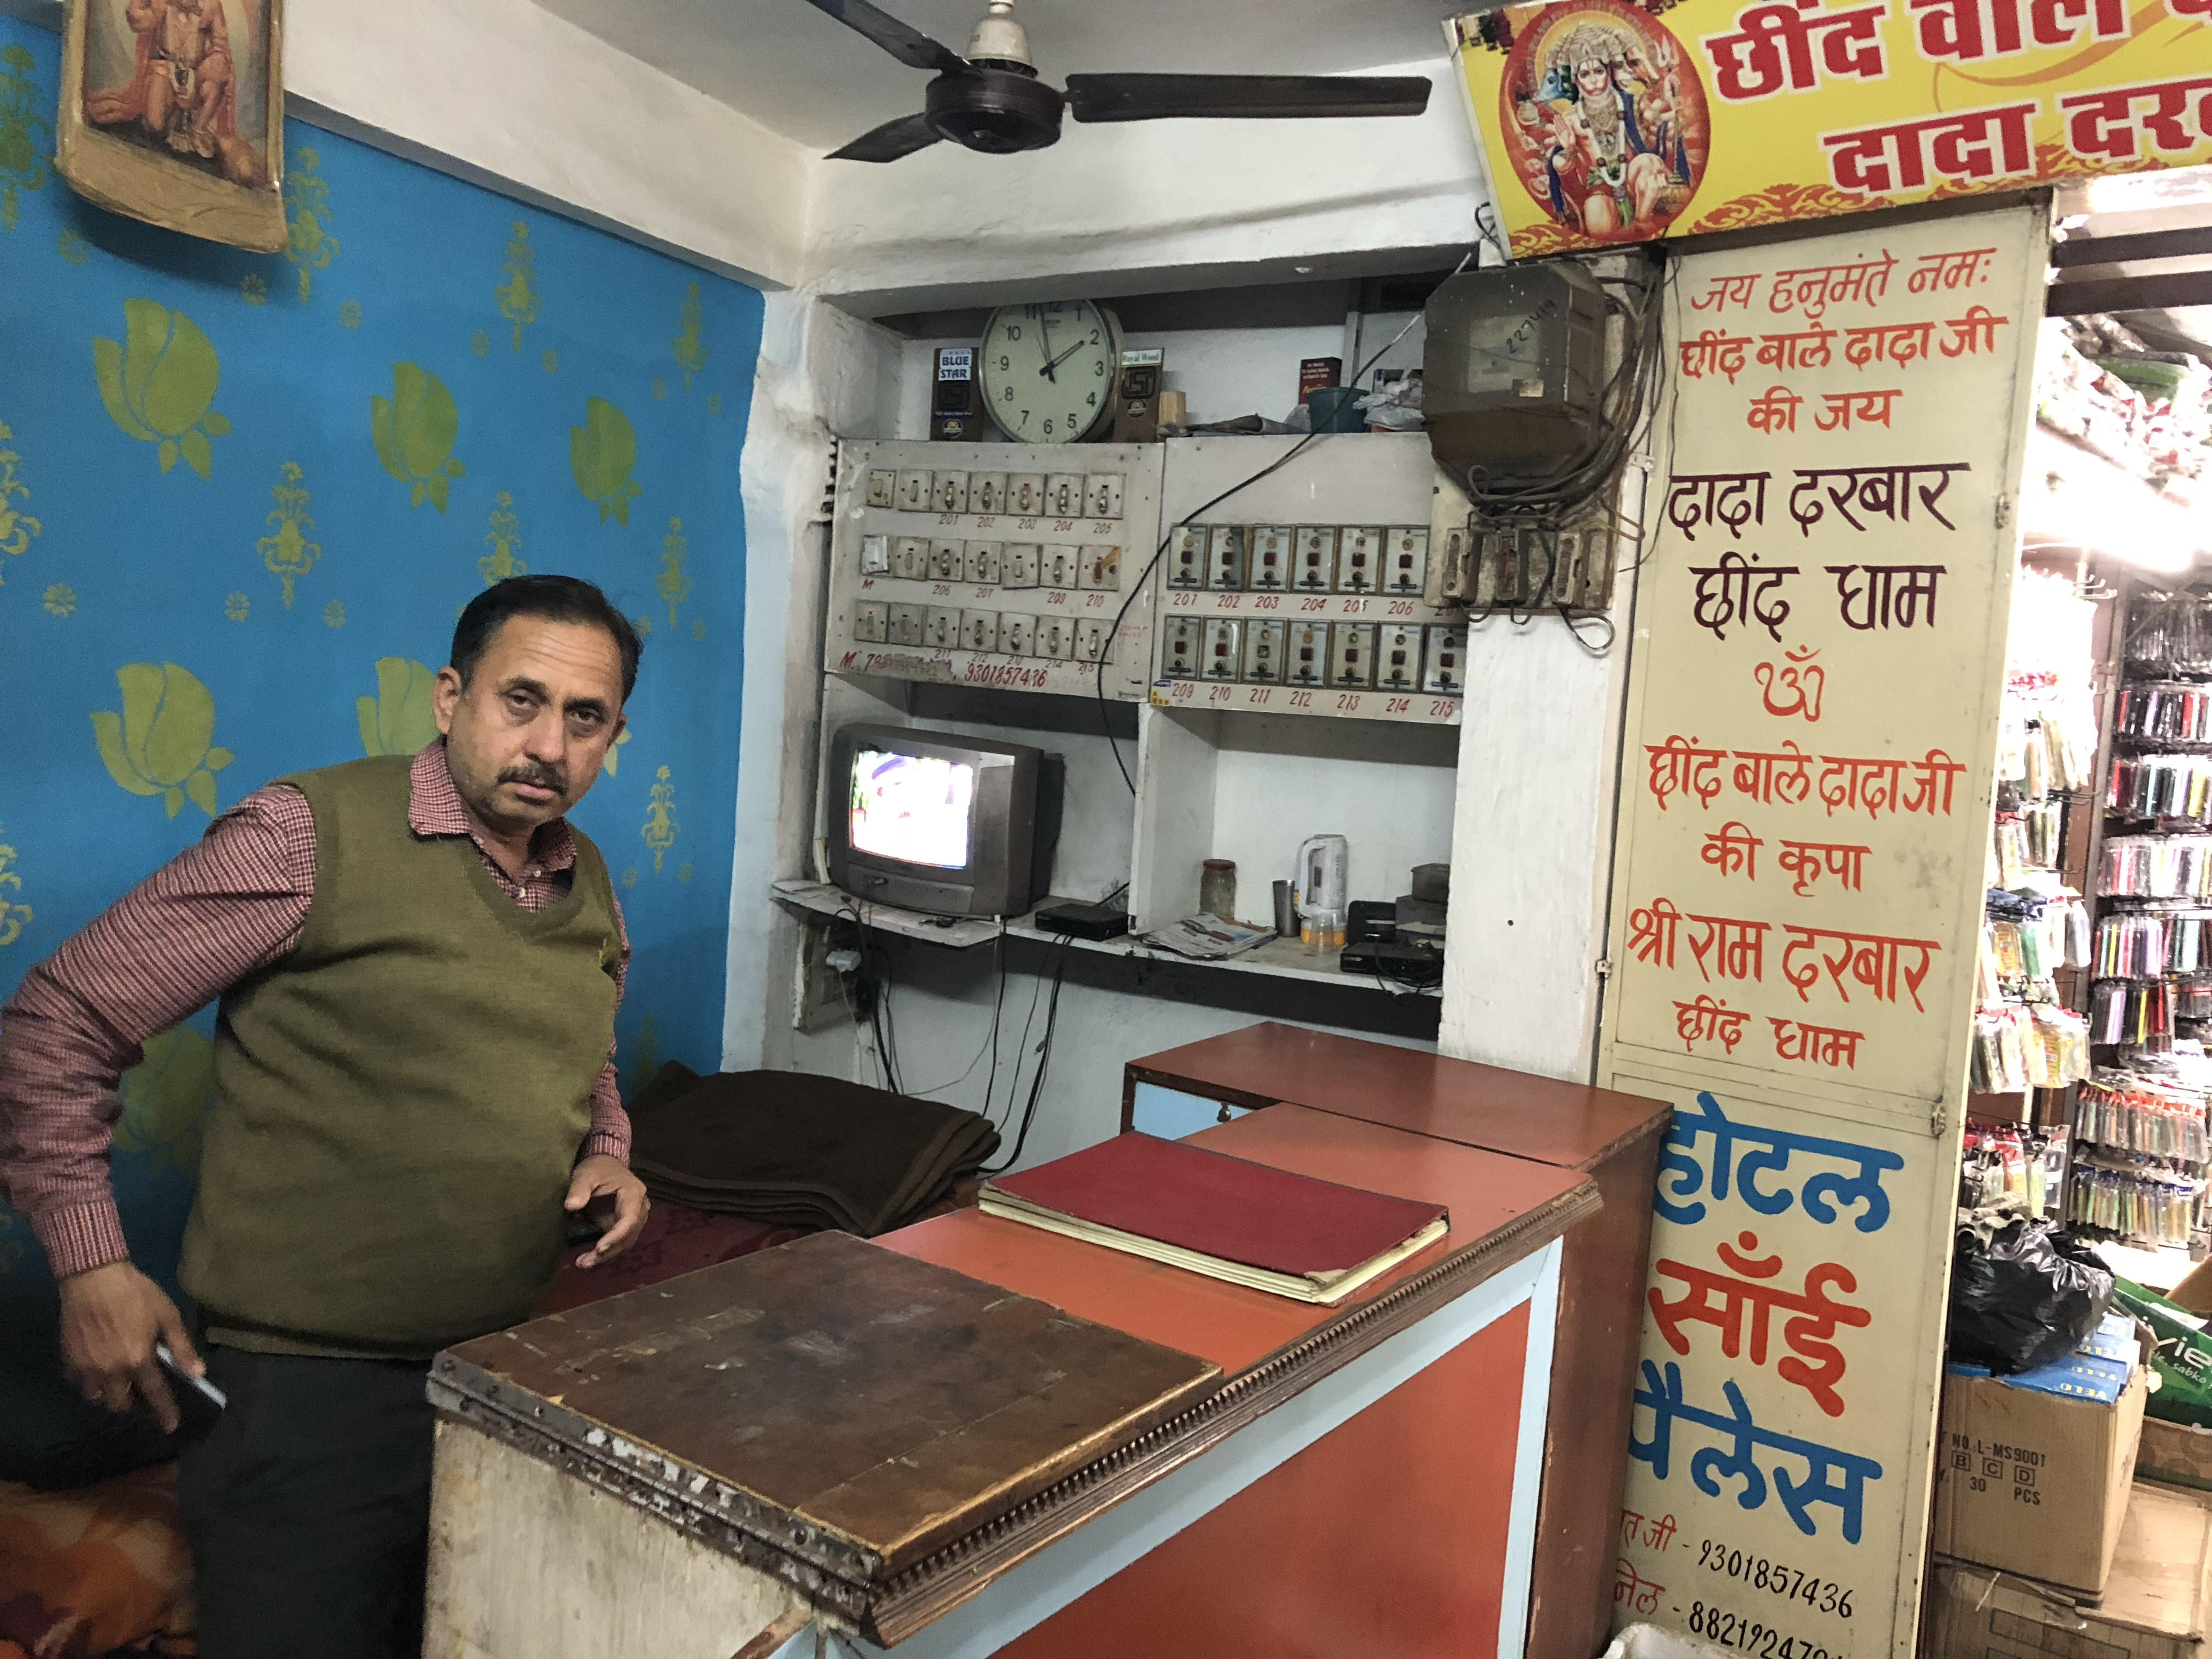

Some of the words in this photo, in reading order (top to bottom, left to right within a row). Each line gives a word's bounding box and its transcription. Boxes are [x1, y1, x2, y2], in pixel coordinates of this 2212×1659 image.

[1824, 104, 2036, 192] दादा
[2062, 78, 2212, 159] दर
[1691, 273, 1762, 312] जय
[1769, 249, 1899, 319] हनुमंते
[1908, 247, 1997, 293] नमः
[1006, 326, 1021, 341] 10
[1090, 329, 1100, 345] 2
[1679, 329, 1753, 385] छींद
[1844, 321, 1937, 372] दादा
[1939, 305, 2010, 358] जी
[940, 369, 967, 379] STAR
[941, 356, 969, 366] BLUE
[1000, 356, 1009, 371] 9
[1094, 360, 1104, 377] 3
[1005, 387, 1014, 401] 8
[1086, 392, 1096, 407] 4
[1021, 410, 1030, 425] 7
[1067, 413, 1077, 429] 5
[1747, 386, 1803, 435] की
[1814, 389, 1904, 431] जय
[1043, 419, 1053, 435] 6
[1668, 471, 1772, 541] दादा
[1789, 462, 1972, 538] दरबार
[939, 514, 959, 526] 201
[977, 516, 996, 528] 202
[1018, 518, 1037, 530] 203
[1053, 520, 1073, 532] 204
[1093, 522, 1113, 534] 205
[933, 584, 952, 596] 206
[975, 588, 995, 599] 207
[1086, 594, 1105, 608] 210
[1173, 593, 1198, 607] 201
[1217, 594, 1240, 610] 202
[1254, 595, 1280, 610] 203
[1301, 597, 1328, 612] 204
[1342, 598, 1369, 613] 205
[1387, 601, 1414, 616] 206
[1687, 550, 1801, 643] छींद
[1171, 682, 1194, 699] 209
[1209, 686, 1232, 702] 210
[1249, 688, 1271, 704] 211
[1289, 691, 1313, 708] 212
[1336, 694, 1361, 711] 213
[1385, 697, 1410, 714] 214
[1429, 701, 1455, 718] 215
[1643, 735, 1729, 811] छींद
[1731, 740, 1814, 805] बाले
[1818, 755, 1908, 820] दादा
[1903, 749, 1968, 817] जी
[1701, 821, 1764, 882] की
[1778, 839, 1873, 898] कृपा
[1627, 897, 1683, 971] श्री
[1685, 913, 1773, 984] राम
[1781, 924, 1943, 1013] दरबार
[1671, 994, 1752, 1056] छींद
[1653, 1090, 1905, 1233] होटल
[2172, 1363, 2207, 1384] sabko
[1628, 1359, 1883, 1545] पैलेस
[1969, 1476, 1987, 1492] 30
[2013, 1487, 2041, 1505] PCS
[1698, 1539, 1854, 1619] 9301857436
[1689, 1600, 1843, 1659] 88219247
